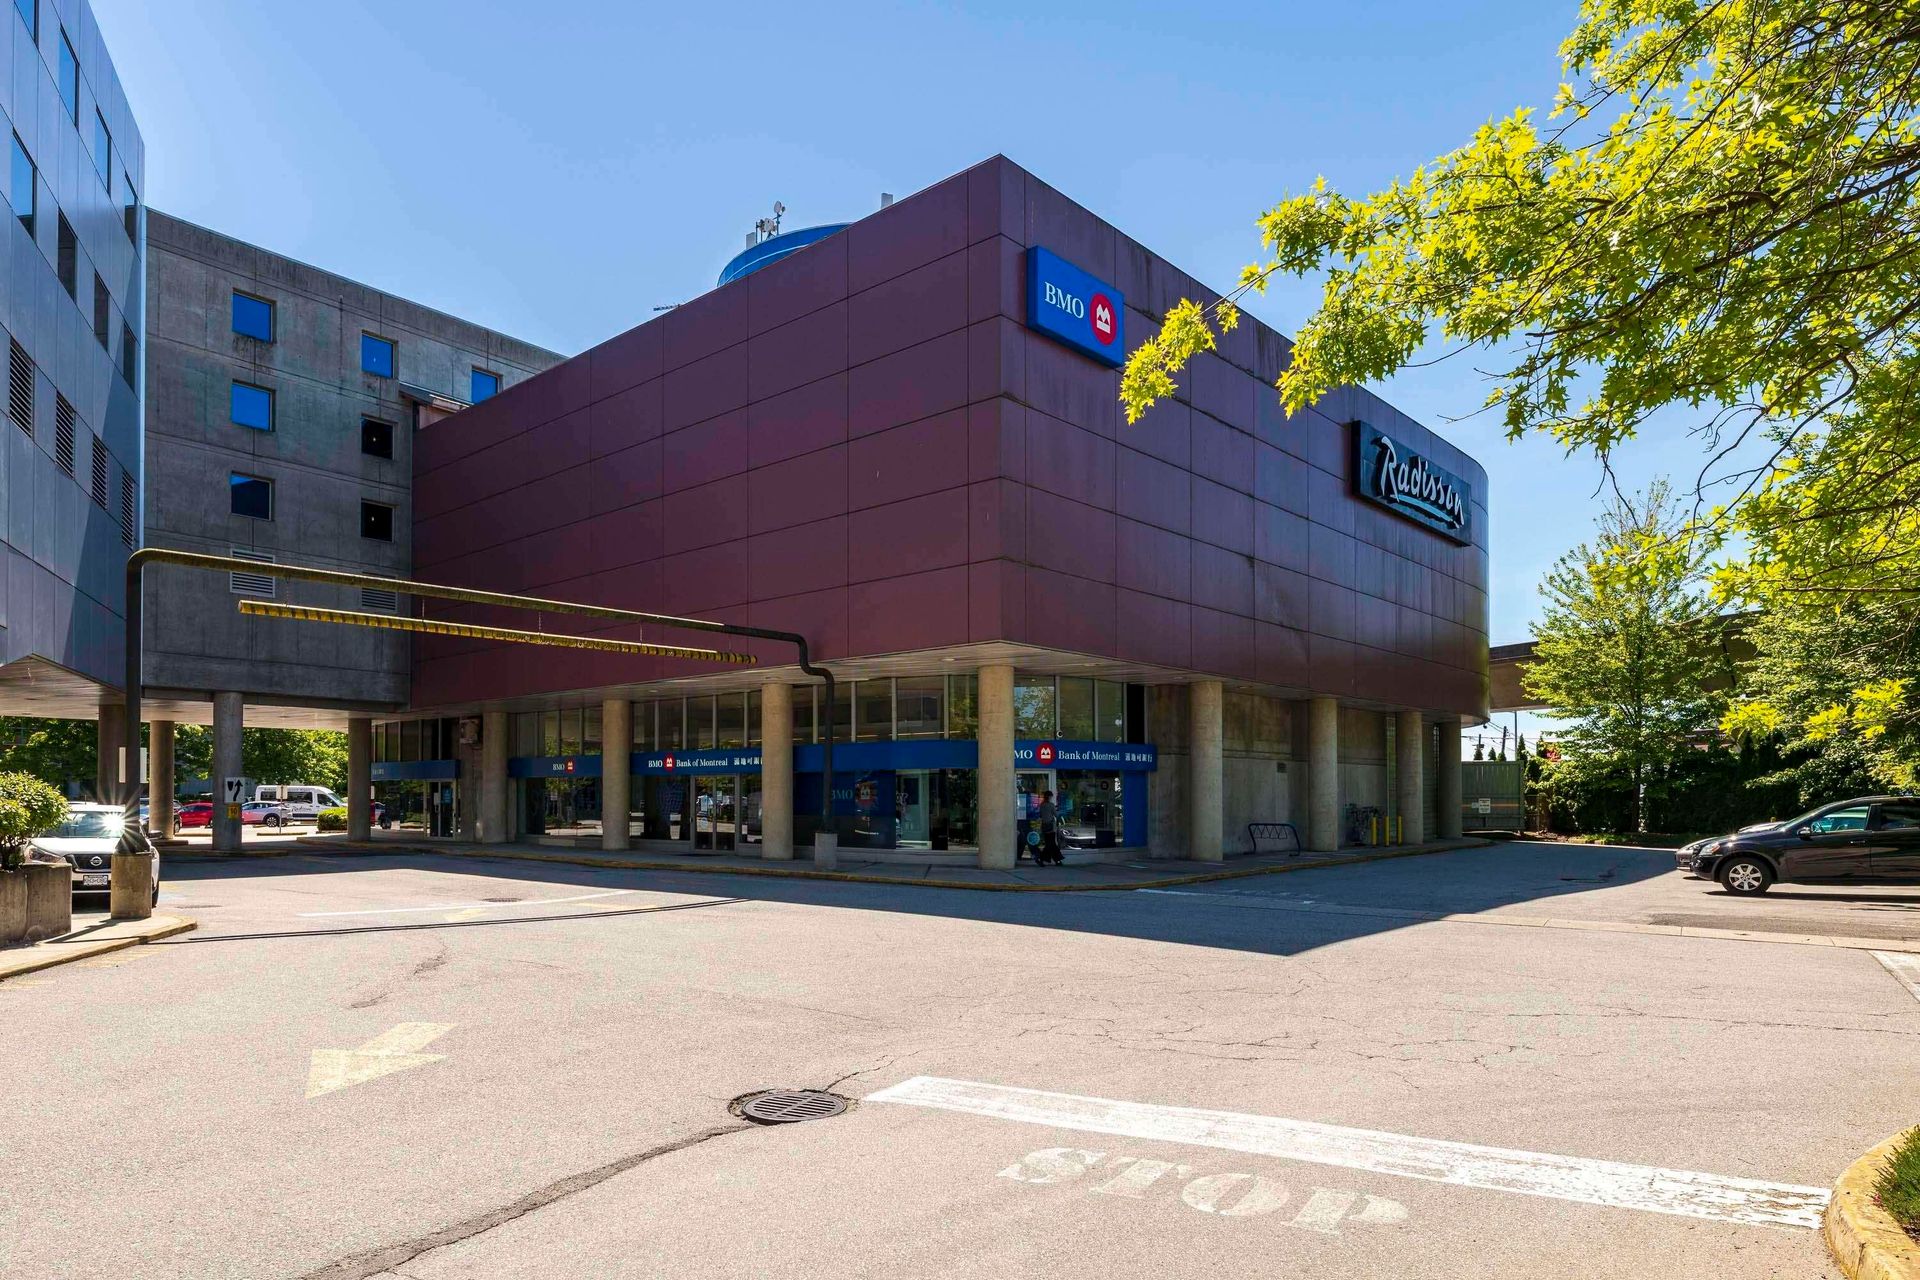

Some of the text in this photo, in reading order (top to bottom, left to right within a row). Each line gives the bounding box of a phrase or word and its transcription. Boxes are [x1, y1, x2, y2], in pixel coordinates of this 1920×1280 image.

[1044, 281, 1085, 319] BMO
[1380, 435, 1465, 527] Radisson
[648, 759, 663, 768] BMO
[676, 759, 692, 768] Bank
[692, 758, 700, 767] of
[699, 758, 728, 768] Montreal
[1014, 749, 1033, 759] MO
[1058, 750, 1081, 760] Bank
[1082, 750, 1091, 760] of
[1091, 751, 1120, 761] Montreal
[995, 1147, 1409, 1237] STOP
